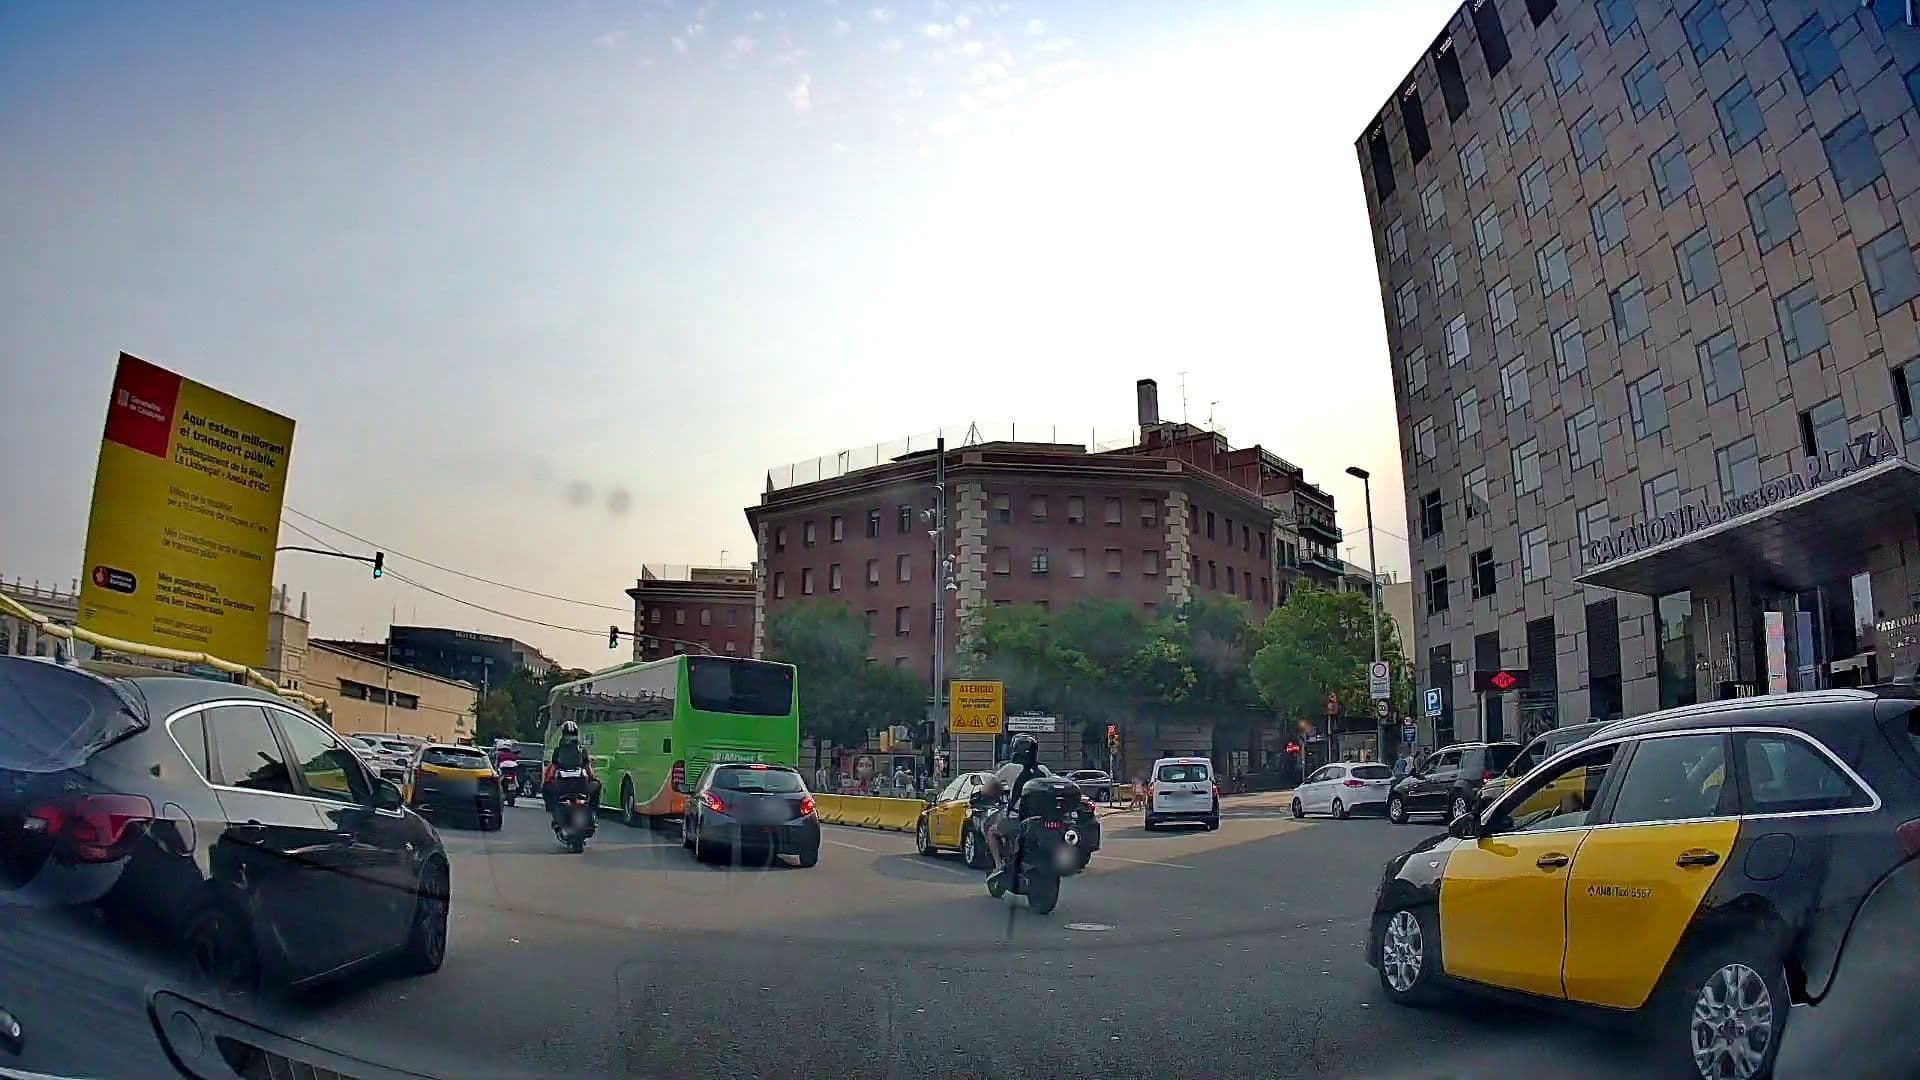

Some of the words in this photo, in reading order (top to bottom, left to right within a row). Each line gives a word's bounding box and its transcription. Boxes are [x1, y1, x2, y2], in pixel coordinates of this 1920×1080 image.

[179, 425, 190, 437] el
[193, 430, 247, 457] transport
[182, 409, 206, 428] Aquí
[207, 420, 240, 440] estem
[241, 432, 285, 456] millorant
[1590, 498, 1713, 565] CATALONIA
[1711, 472, 1802, 524] BARCELONA
[1803, 424, 1898, 489] PLAZA
[1428, 692, 1438, 710] P
[1733, 684, 1754, 698] TAXI
[1615, 886, 1629, 897] Taxi
